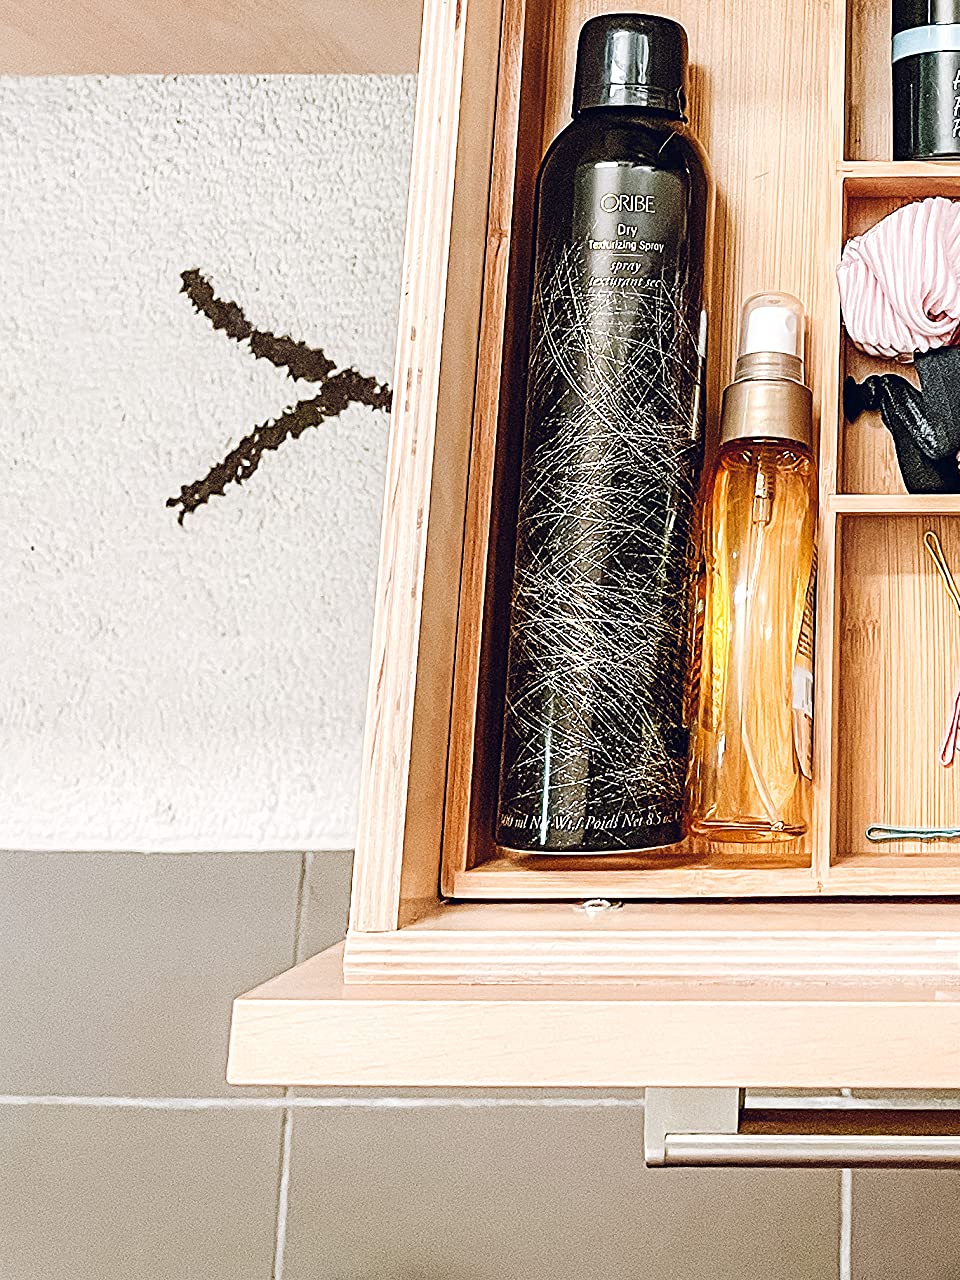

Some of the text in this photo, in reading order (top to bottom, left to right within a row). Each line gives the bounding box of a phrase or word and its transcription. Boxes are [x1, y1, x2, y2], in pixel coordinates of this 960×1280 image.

[601, 193, 655, 213] ORIBE
[618, 223, 637, 237] Dry
[589, 239, 664, 253] Texturizing Spray
[610, 261, 641, 274] spray
